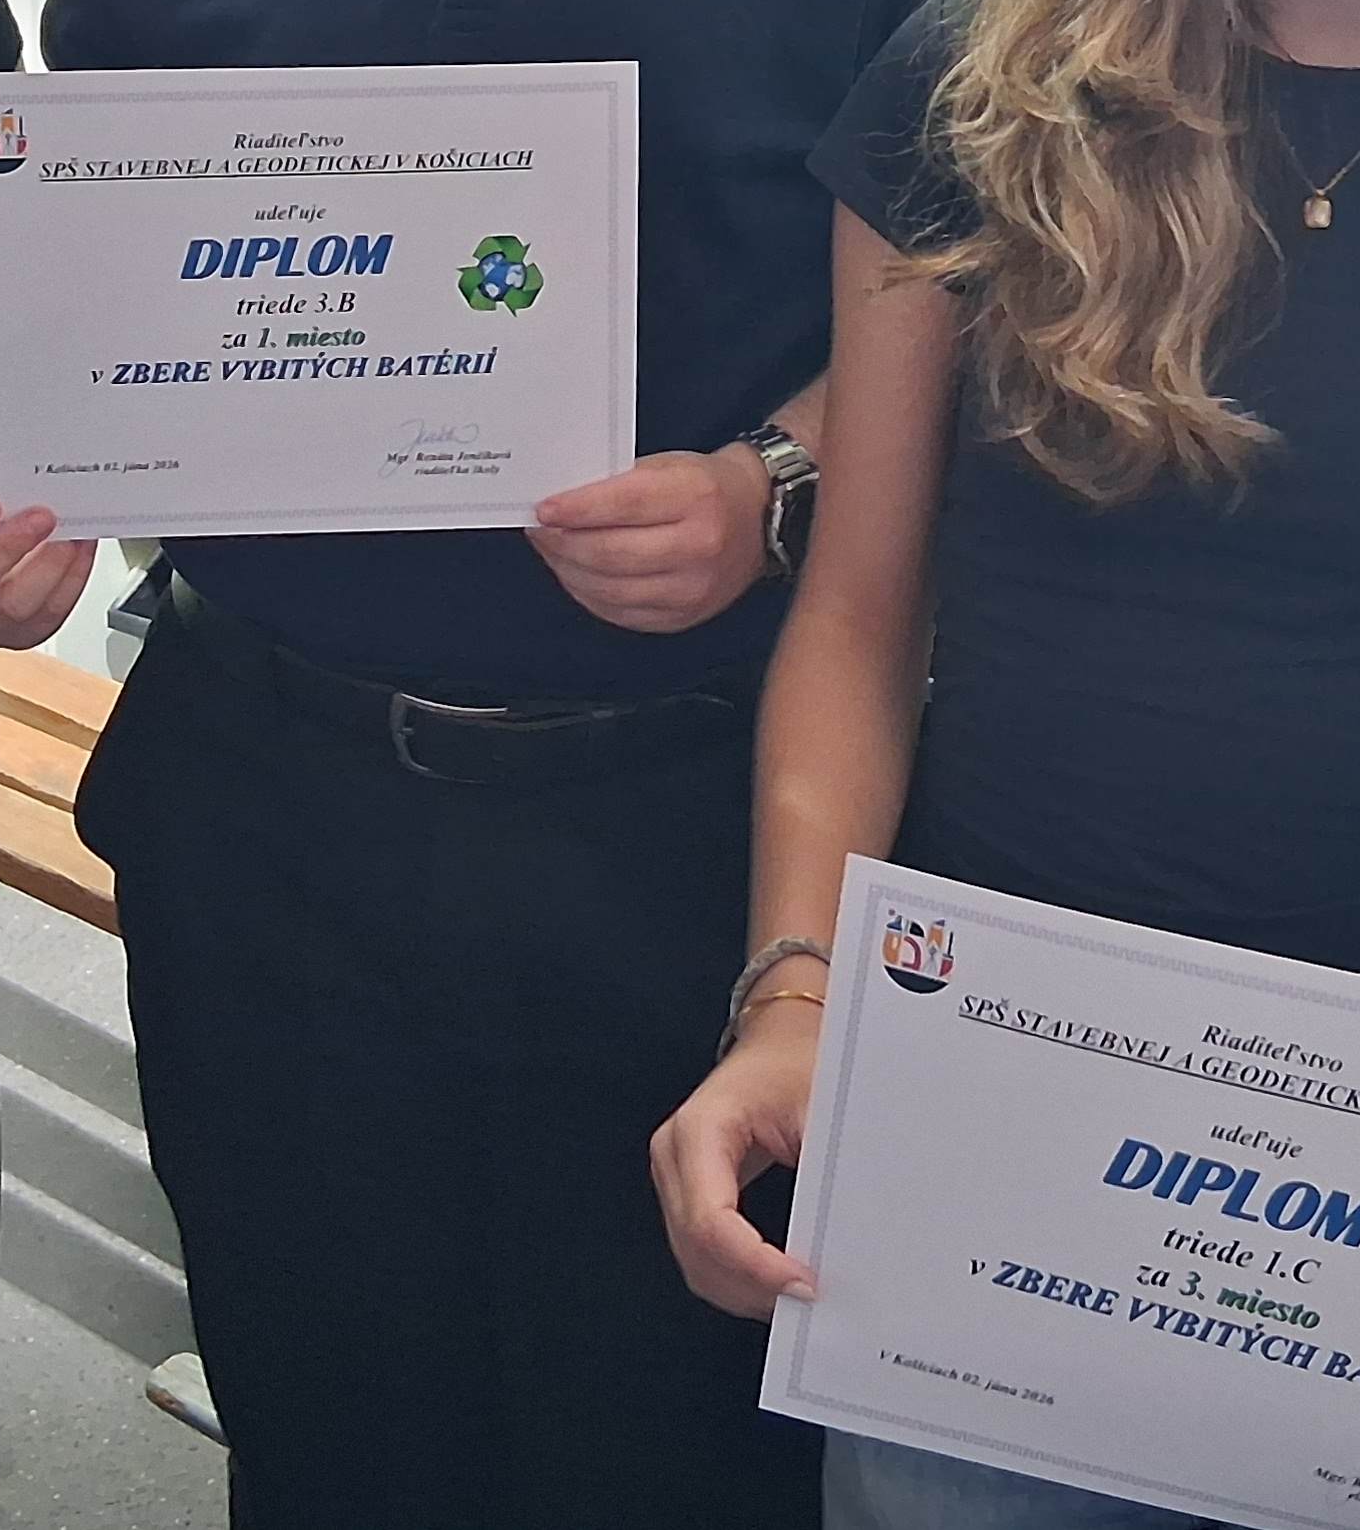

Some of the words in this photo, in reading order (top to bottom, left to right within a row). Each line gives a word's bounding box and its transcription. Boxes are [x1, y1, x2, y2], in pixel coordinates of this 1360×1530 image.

[234, 133, 344, 150] Riaditeľstvo
[39, 158, 78, 176] SPŠ
[84, 159, 211, 176] STAVEBNEJ
[216, 160, 229, 173] A
[238, 155, 390, 172] GEODETICKEJ
[397, 154, 410, 168] V
[416, 149, 533, 169] KOŠICIACH
[255, 205, 327, 224] udeľuje
[181, 235, 394, 280] DIPLOM
[237, 294, 308, 316] triede
[315, 293, 356, 314] 3.B
[222, 334, 247, 350] za
[258, 328, 277, 349] 1.
[287, 327, 366, 348] miesto
[91, 371, 104, 384] v
[111, 362, 212, 385] ZBERE
[223, 352, 368, 381] VYBITÝCH
[375, 347, 498, 377] BATÉRIÍ
[959, 995, 1008, 1024] SPŠ
[1009, 1010, 1170, 1062] STAVEBNEJ
[1173, 1052, 1193, 1070] A
[1202, 1025, 1343, 1072] Riaditeľstvo
[1211, 1126, 1304, 1160] udeľuje
[1164, 1229, 1254, 1268] triede
[1264, 1251, 1322, 1285] 1.C
[971, 1260, 986, 1276] v
[992, 1261, 1121, 1316] ZBERE
[1129, 1297, 1321, 1371] VYBITÝCH
[1137, 1265, 1171, 1288] za
[1179, 1272, 1205, 1301] 3.
[1217, 1288, 1321, 1329] miesto
